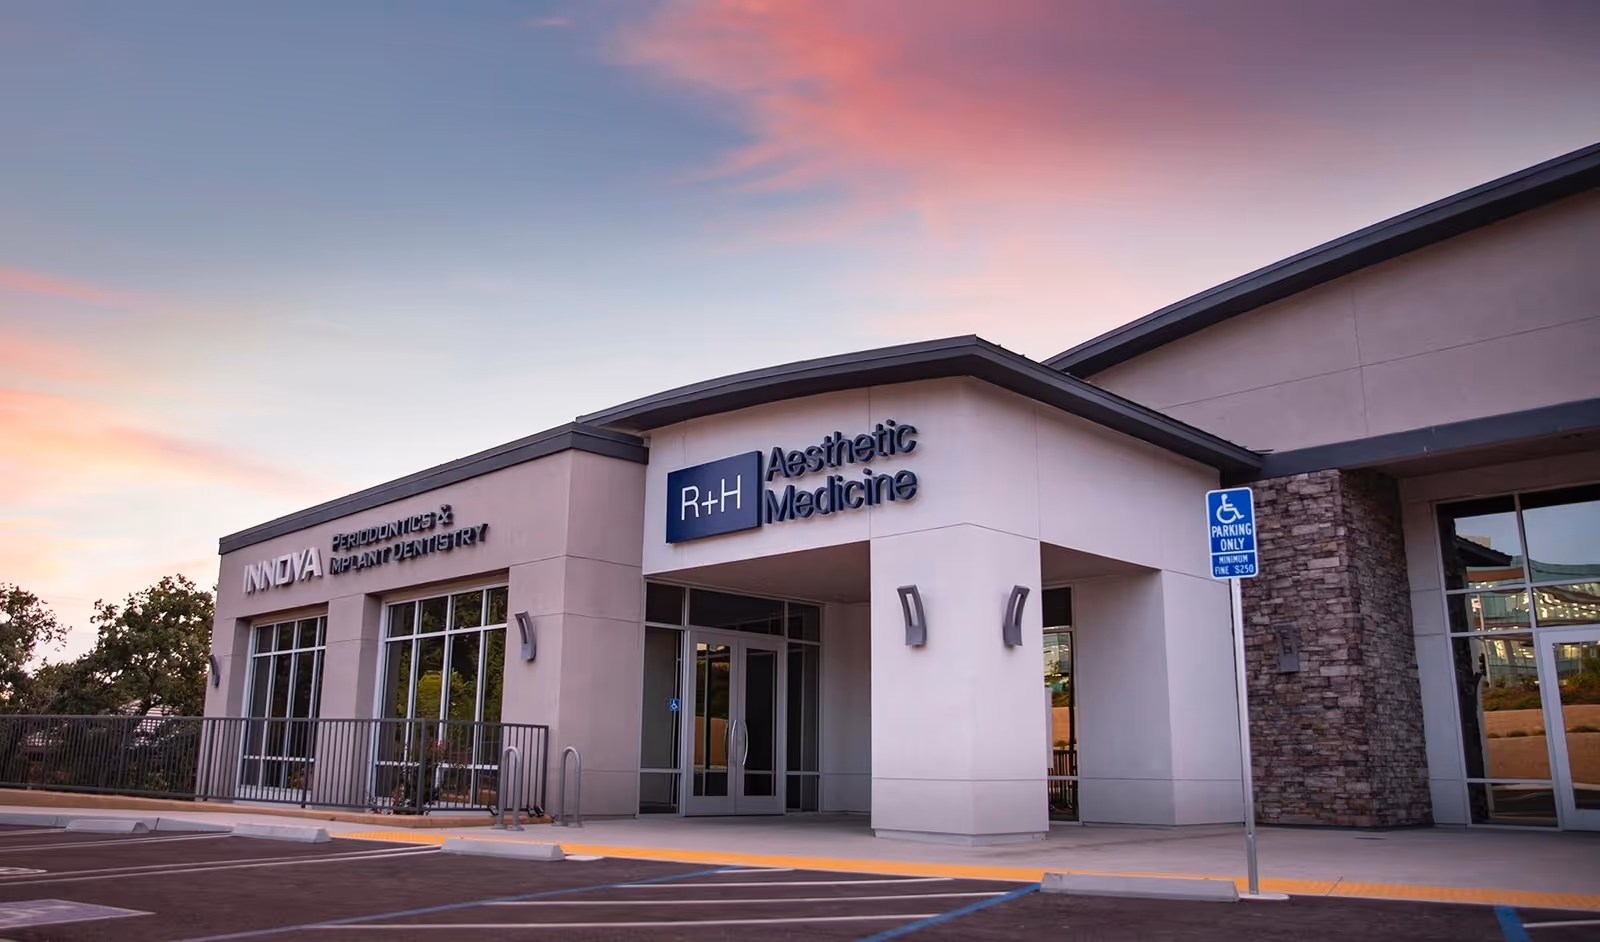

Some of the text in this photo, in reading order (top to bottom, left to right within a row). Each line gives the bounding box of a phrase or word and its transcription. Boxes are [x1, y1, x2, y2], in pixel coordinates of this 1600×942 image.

[765, 419, 917, 482] Aesthetic
[680, 474, 741, 520] R+H
[765, 468, 918, 524] Medicine
[332, 504, 453, 551] PERIODONTICS &
[393, 523, 488, 561] DENTISTRY
[1211, 523, 1252, 538] PARKING
[1220, 537, 1245, 551] ONLY
[242, 546, 323, 593] INNOVA
[1215, 566, 1229, 575] FINE
[1219, 554, 1248, 564] MINIMUM
